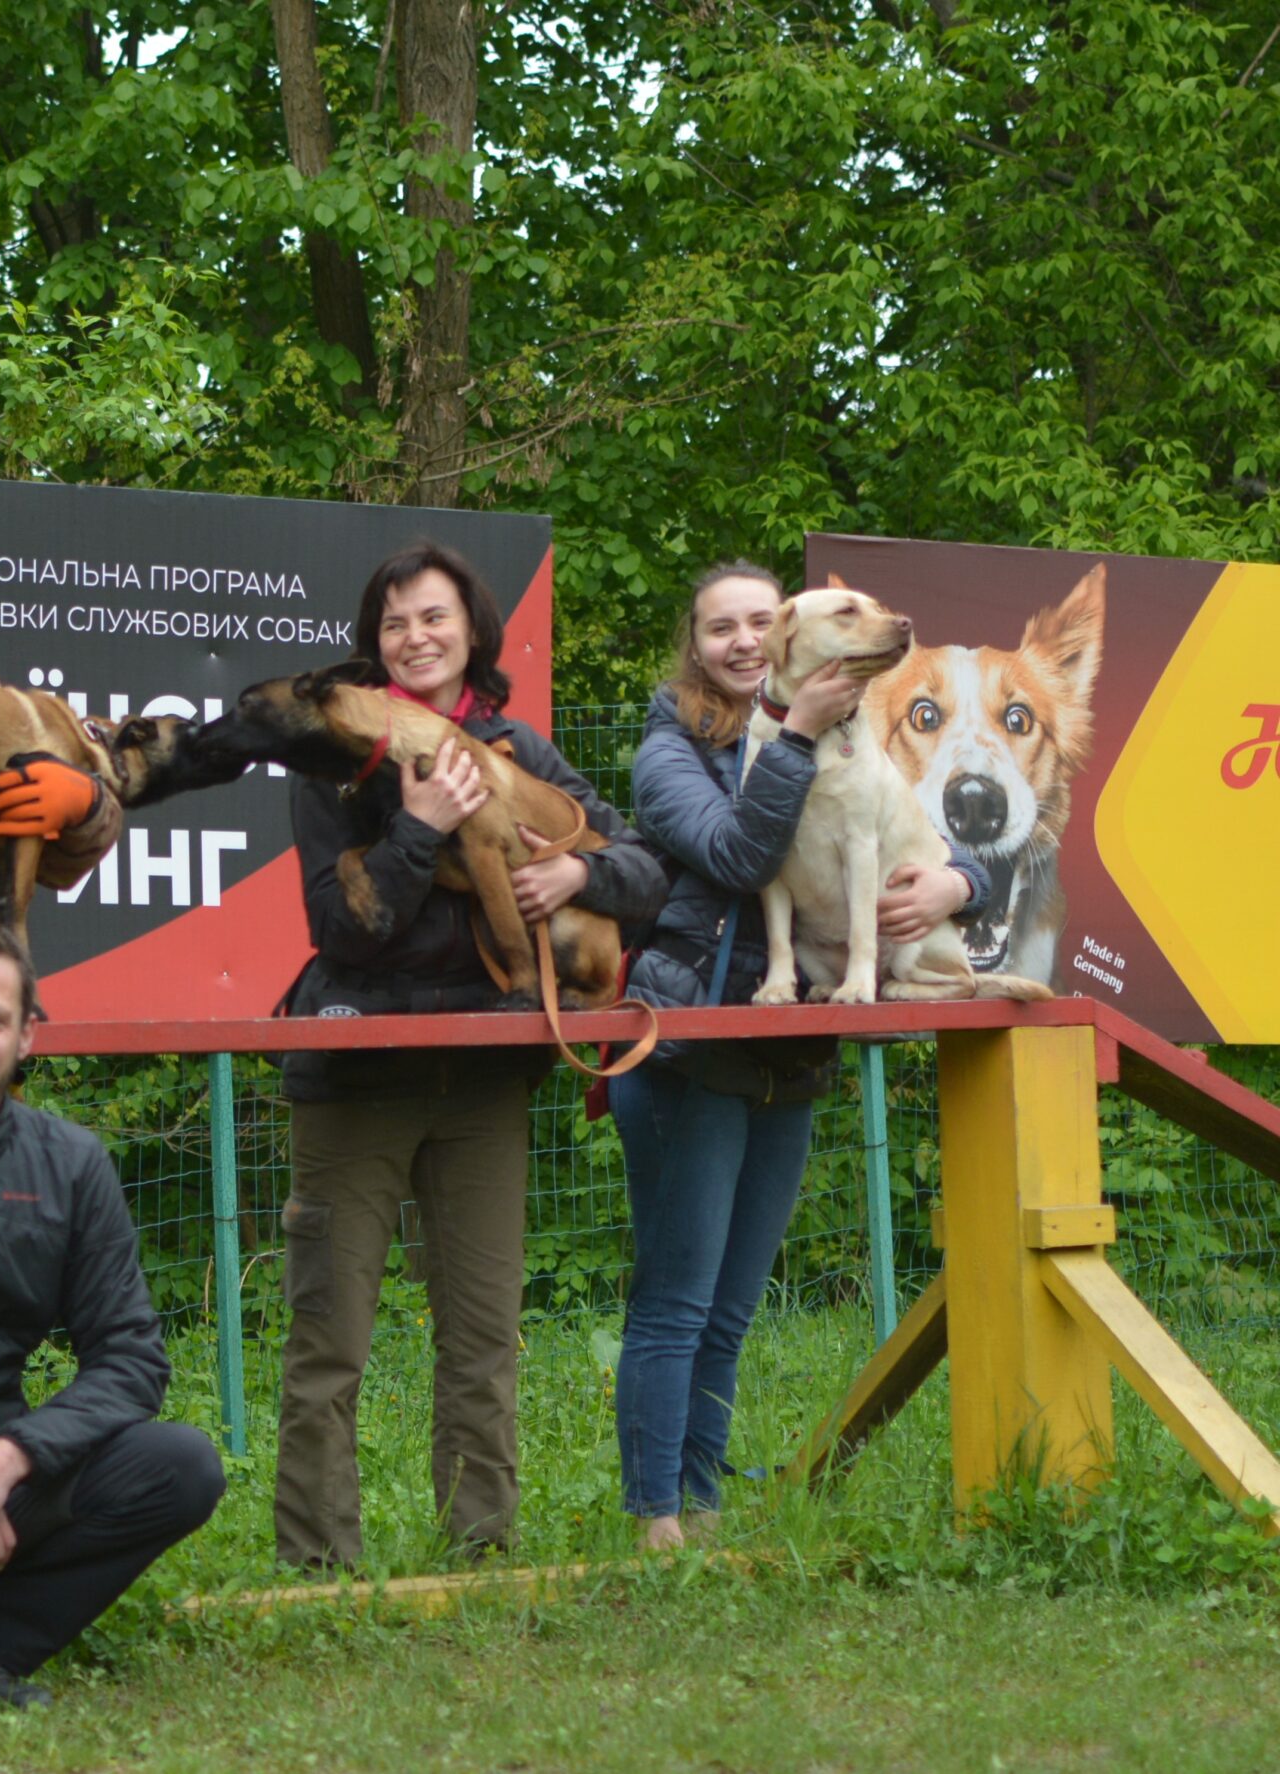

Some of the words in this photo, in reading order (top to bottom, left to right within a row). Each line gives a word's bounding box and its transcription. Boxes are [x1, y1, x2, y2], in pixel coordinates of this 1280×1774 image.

[150, 565, 307, 599] ПРОГРАМА
[67, 606, 249, 640] СЛУЖБОВИХ
[257, 617, 352, 645] СОБАК
[57, 828, 247, 906] ИНГ
[1082, 935, 1113, 963] Made
[1113, 953, 1125, 970] in
[1073, 954, 1124, 994] Germany
